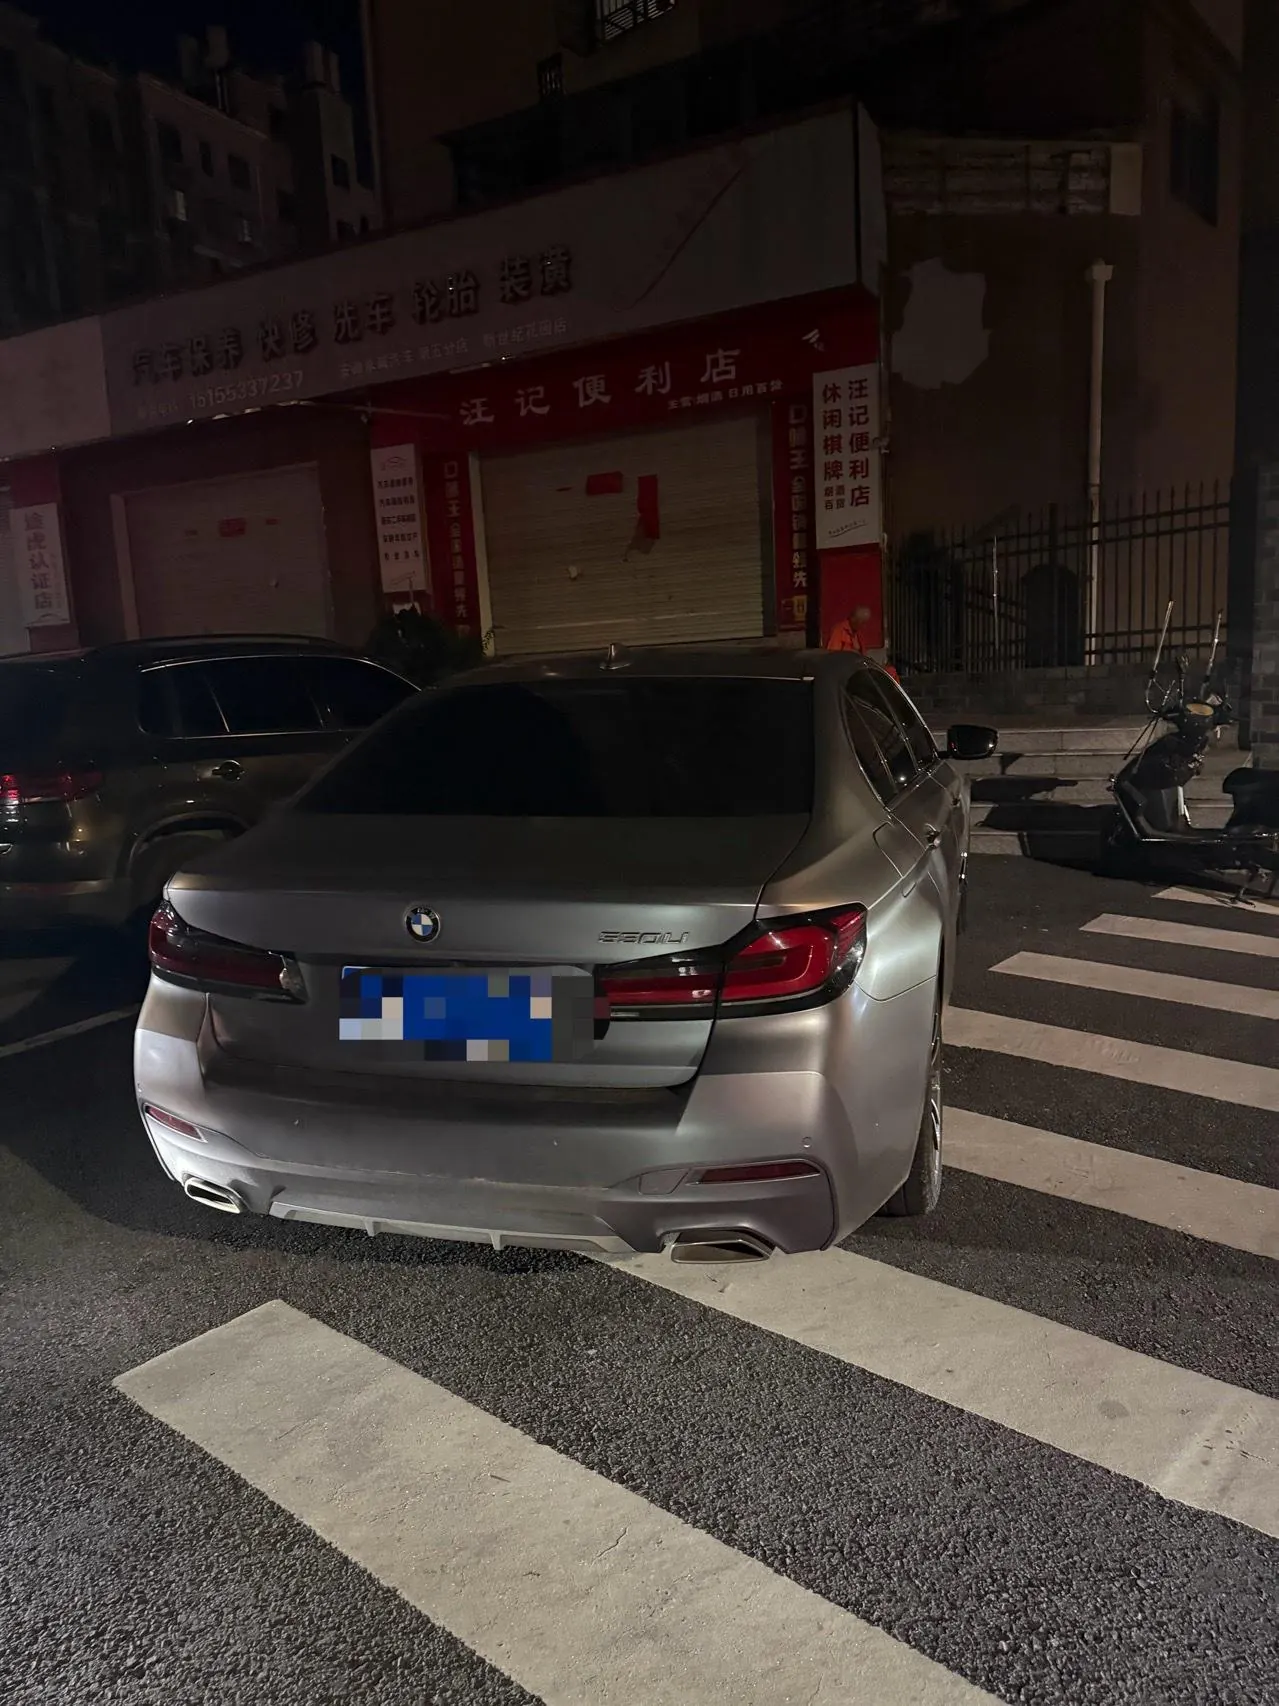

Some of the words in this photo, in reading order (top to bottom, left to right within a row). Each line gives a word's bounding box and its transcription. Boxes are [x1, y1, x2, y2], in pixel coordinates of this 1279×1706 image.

[258, 311, 318, 362] 快修
[334, 293, 396, 344] 洗车
[412, 270, 480, 325] 轮胎
[459, 347, 742, 427] 汪记便利店
[822, 383, 844, 482] 休闲棋牌
[848, 378, 871, 508] 汪记便利店
